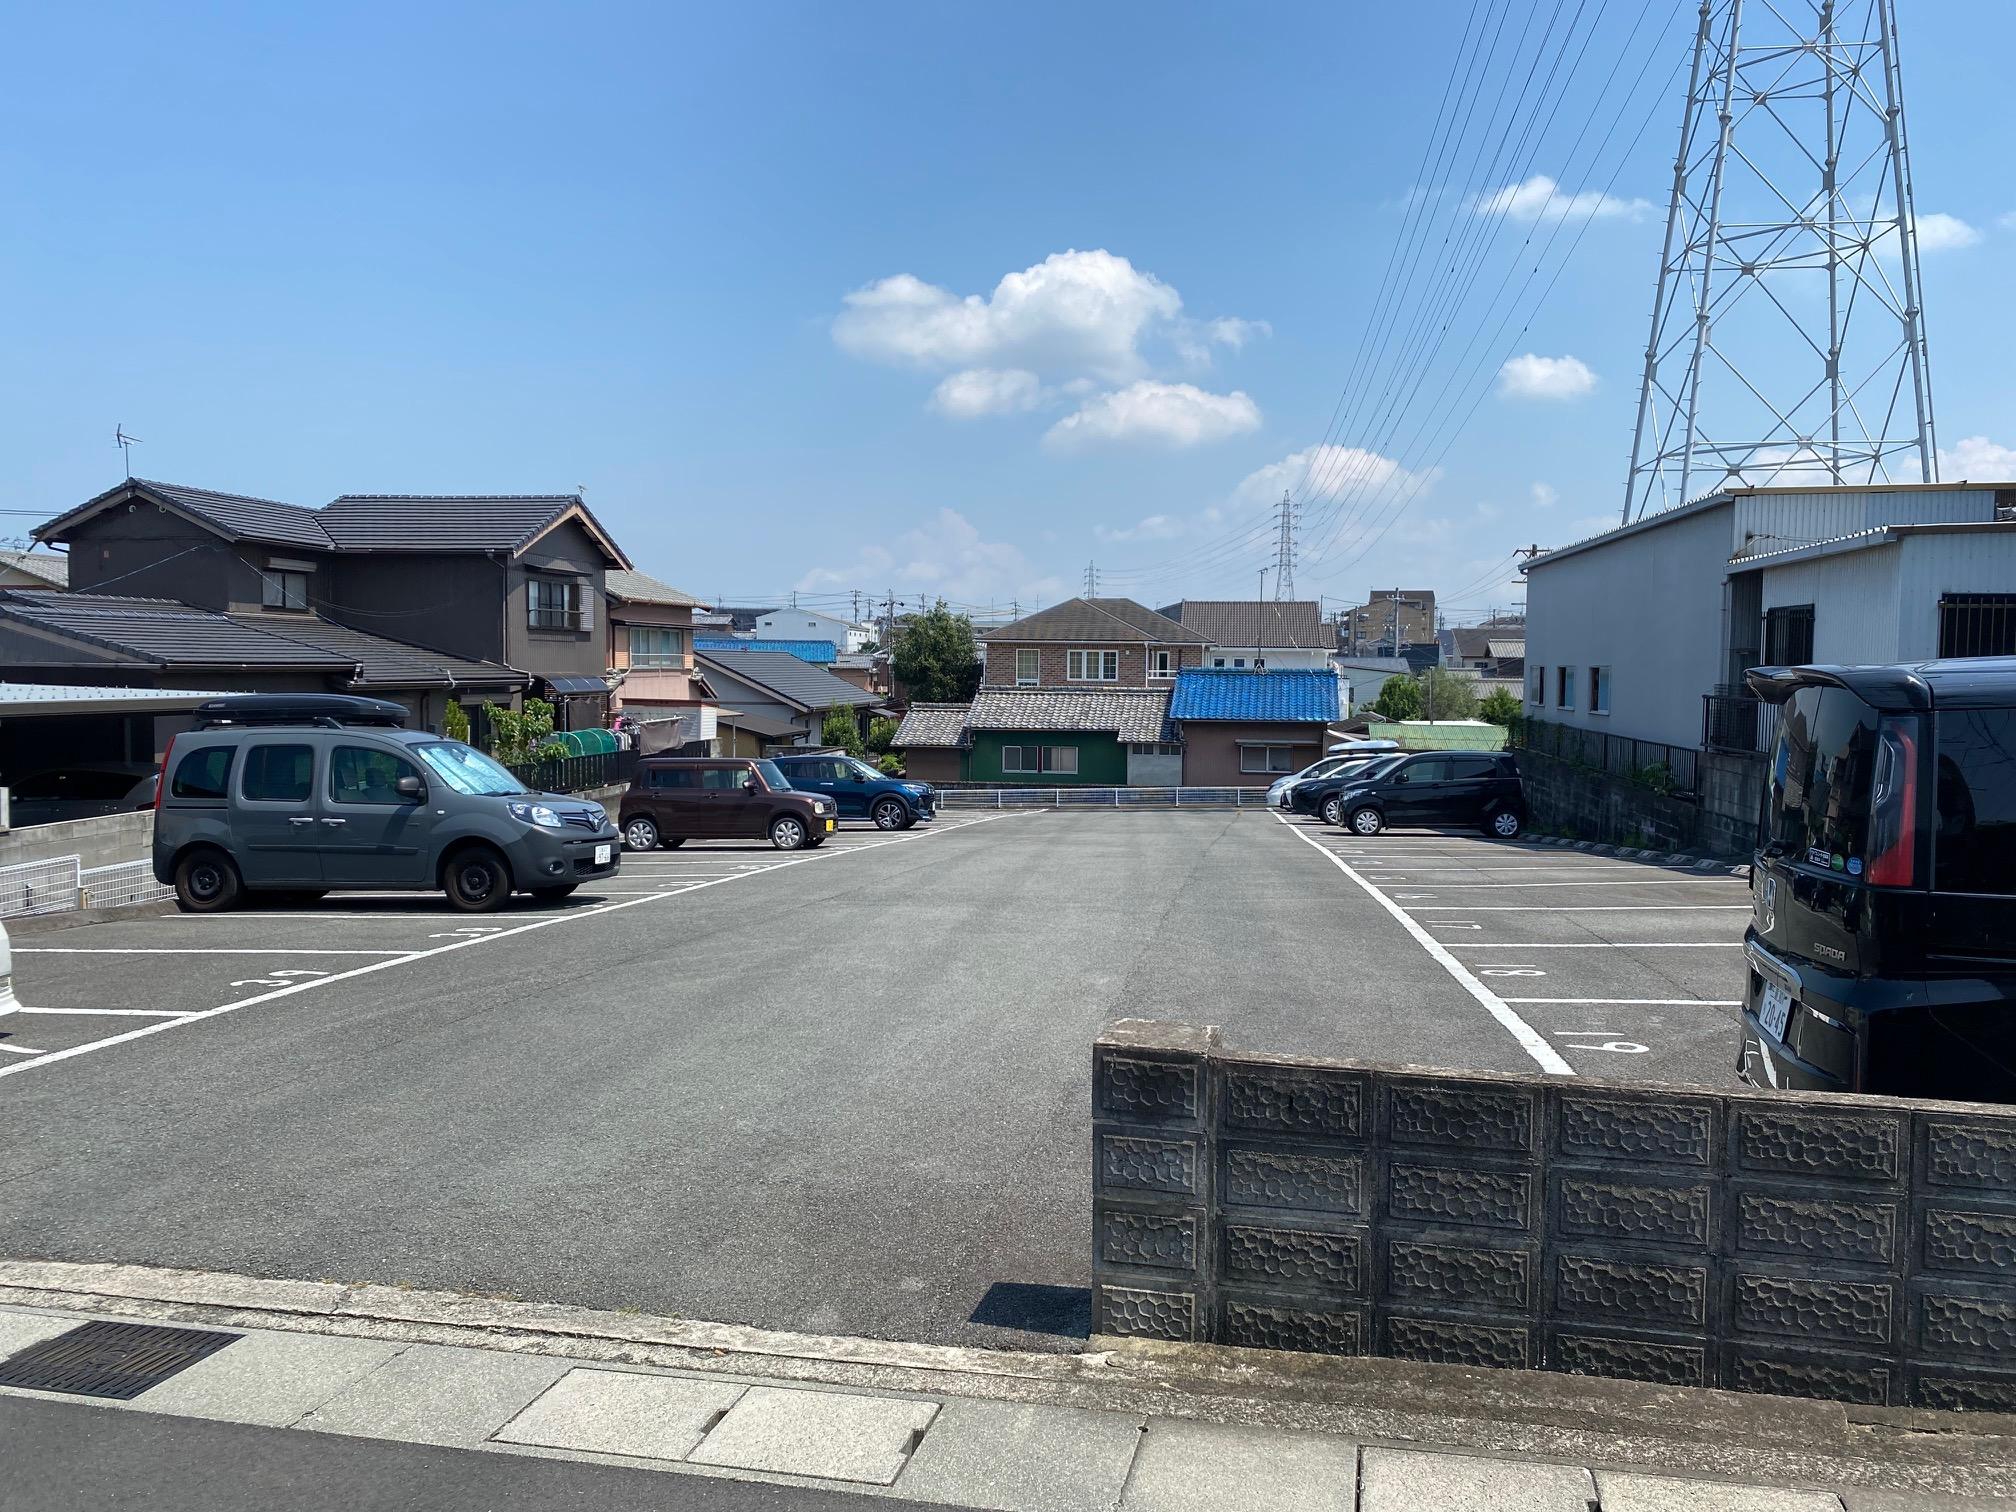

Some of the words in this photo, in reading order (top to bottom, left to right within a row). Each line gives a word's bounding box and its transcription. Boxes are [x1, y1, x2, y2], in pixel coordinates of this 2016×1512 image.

[1813, 942, 1846, 961] SPADA
[230, 970, 330, 987] 39
[1475, 964, 1547, 977] 18
[1553, 1030, 1650, 1054] 19
